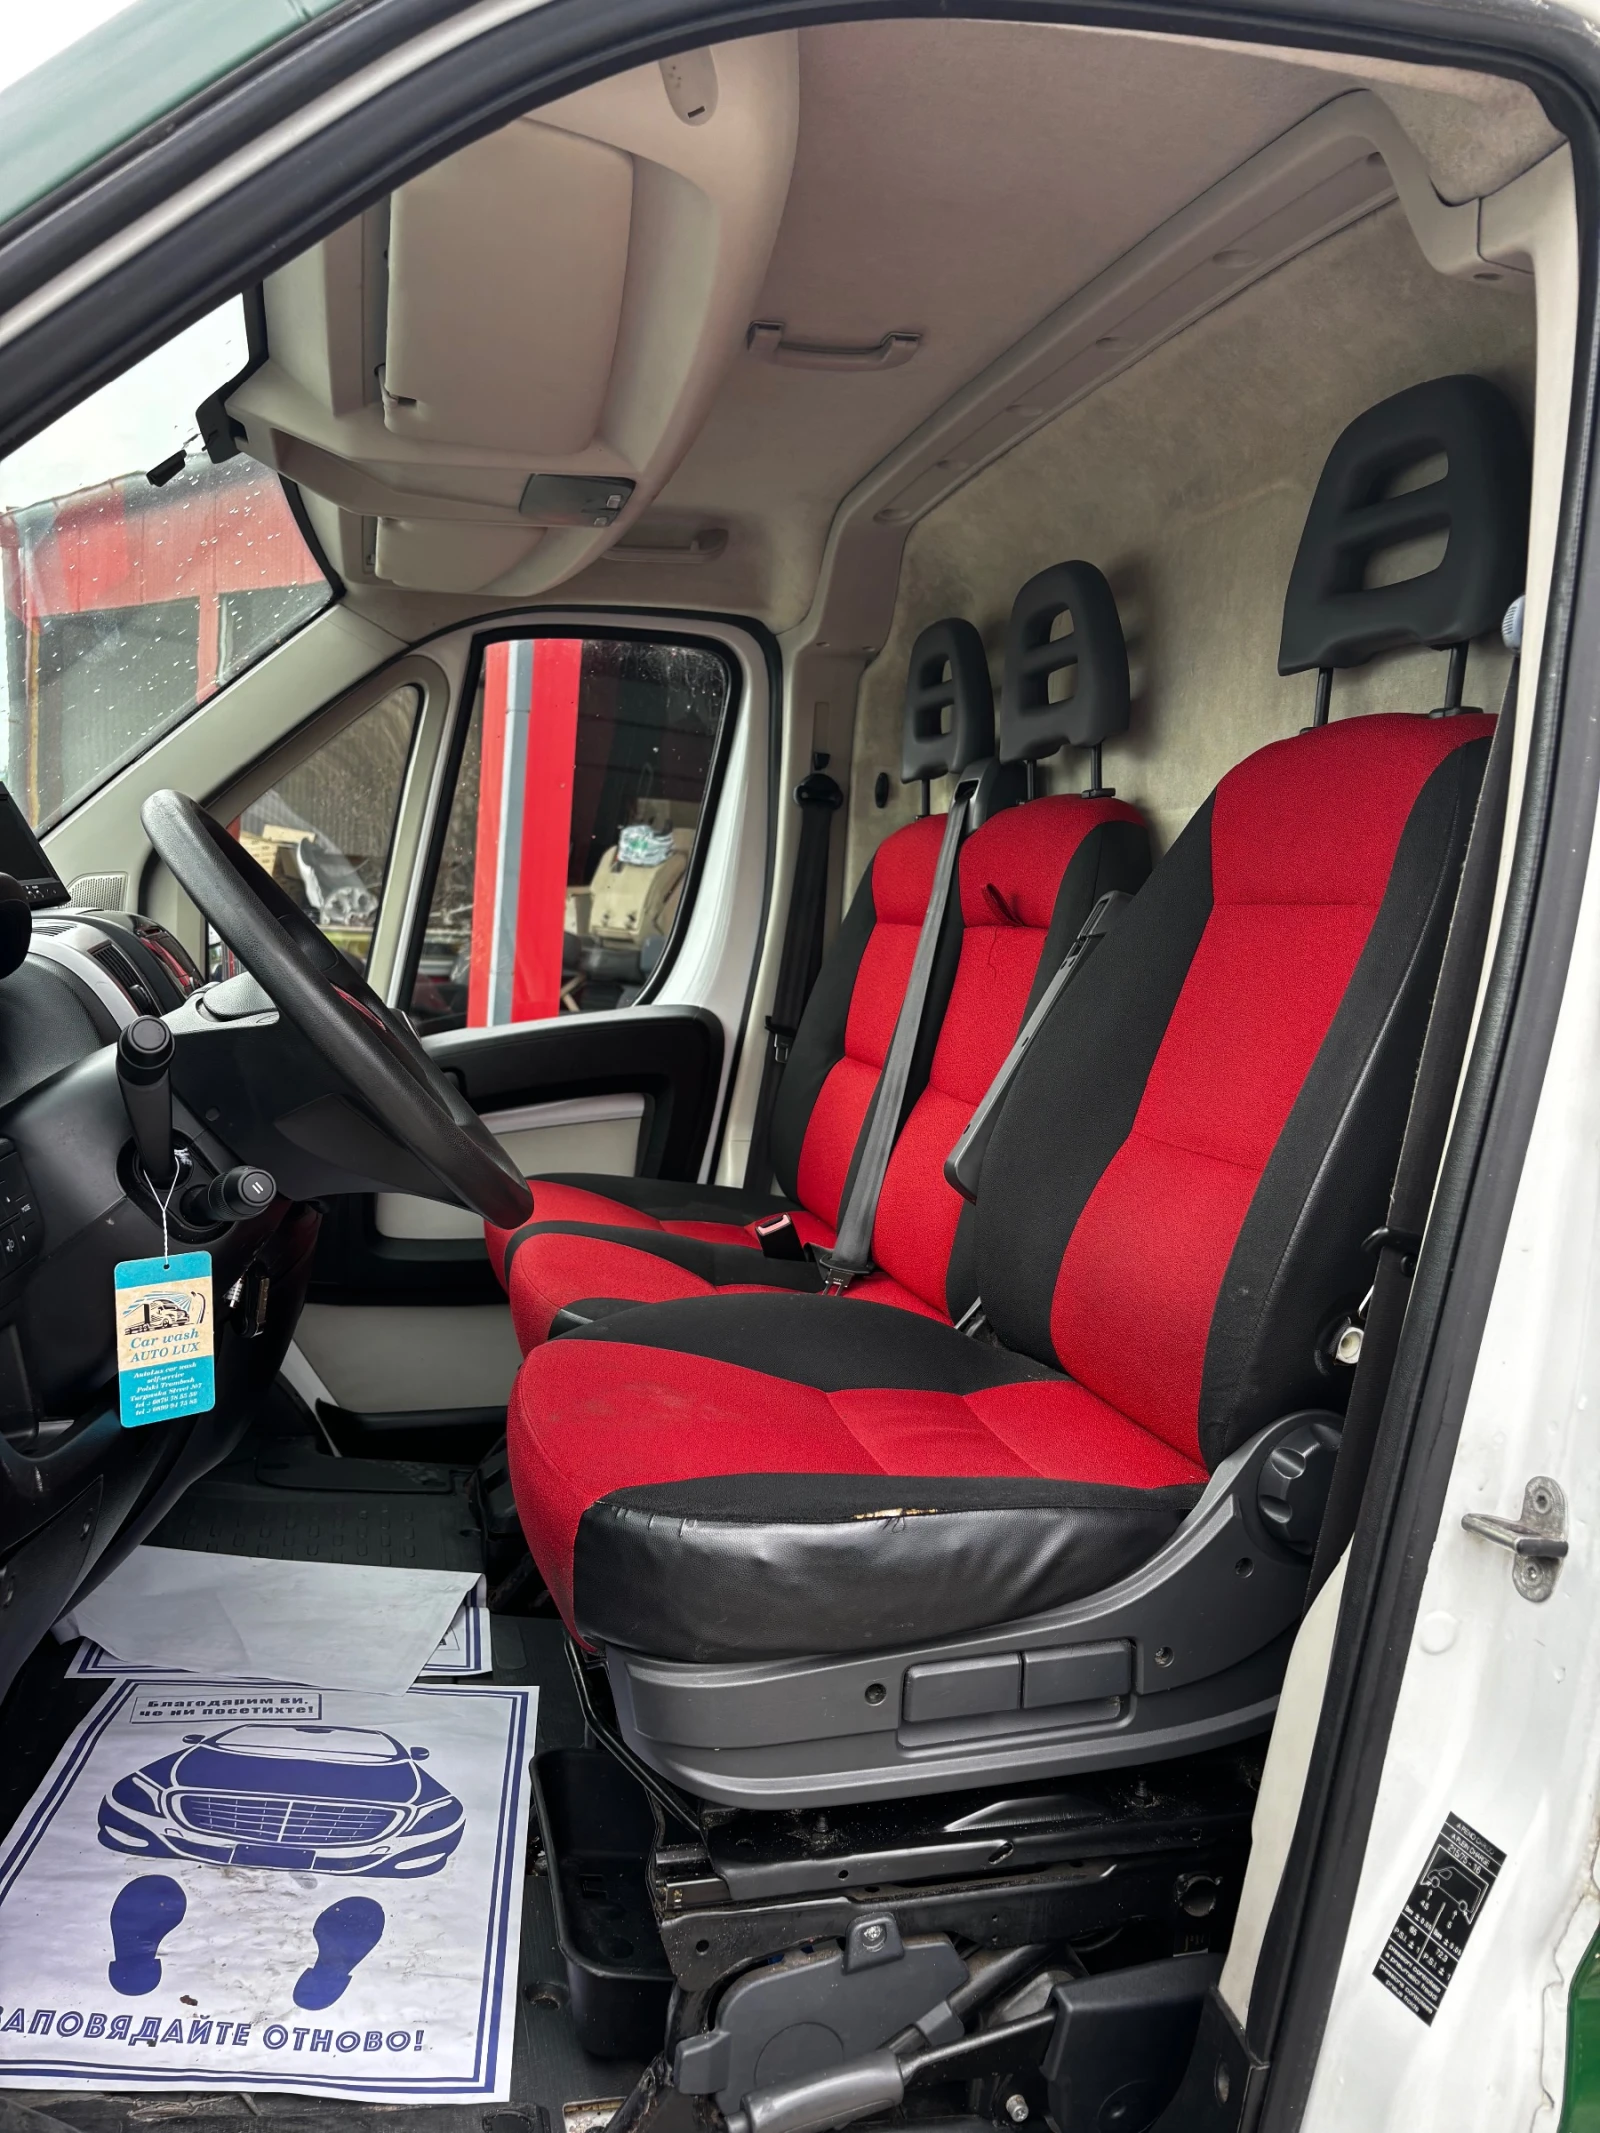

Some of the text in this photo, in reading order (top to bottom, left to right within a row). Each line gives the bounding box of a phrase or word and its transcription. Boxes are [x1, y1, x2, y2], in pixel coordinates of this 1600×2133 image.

[131, 1328, 199, 1348] Car wash
[131, 1342, 200, 1362] AUTO LUX
[147, 1373, 184, 1383] self-service
[147, 1698, 274, 1707] Благодарим
[202, 1706, 313, 1715] посетихте!
[1448, 1844, 1468, 1864] 215/75
[1456, 1836, 1470, 1850] PLEIN
[1469, 1847, 1490, 1868] CHARGE
[262, 2024, 425, 2054] ОТНОВО!
